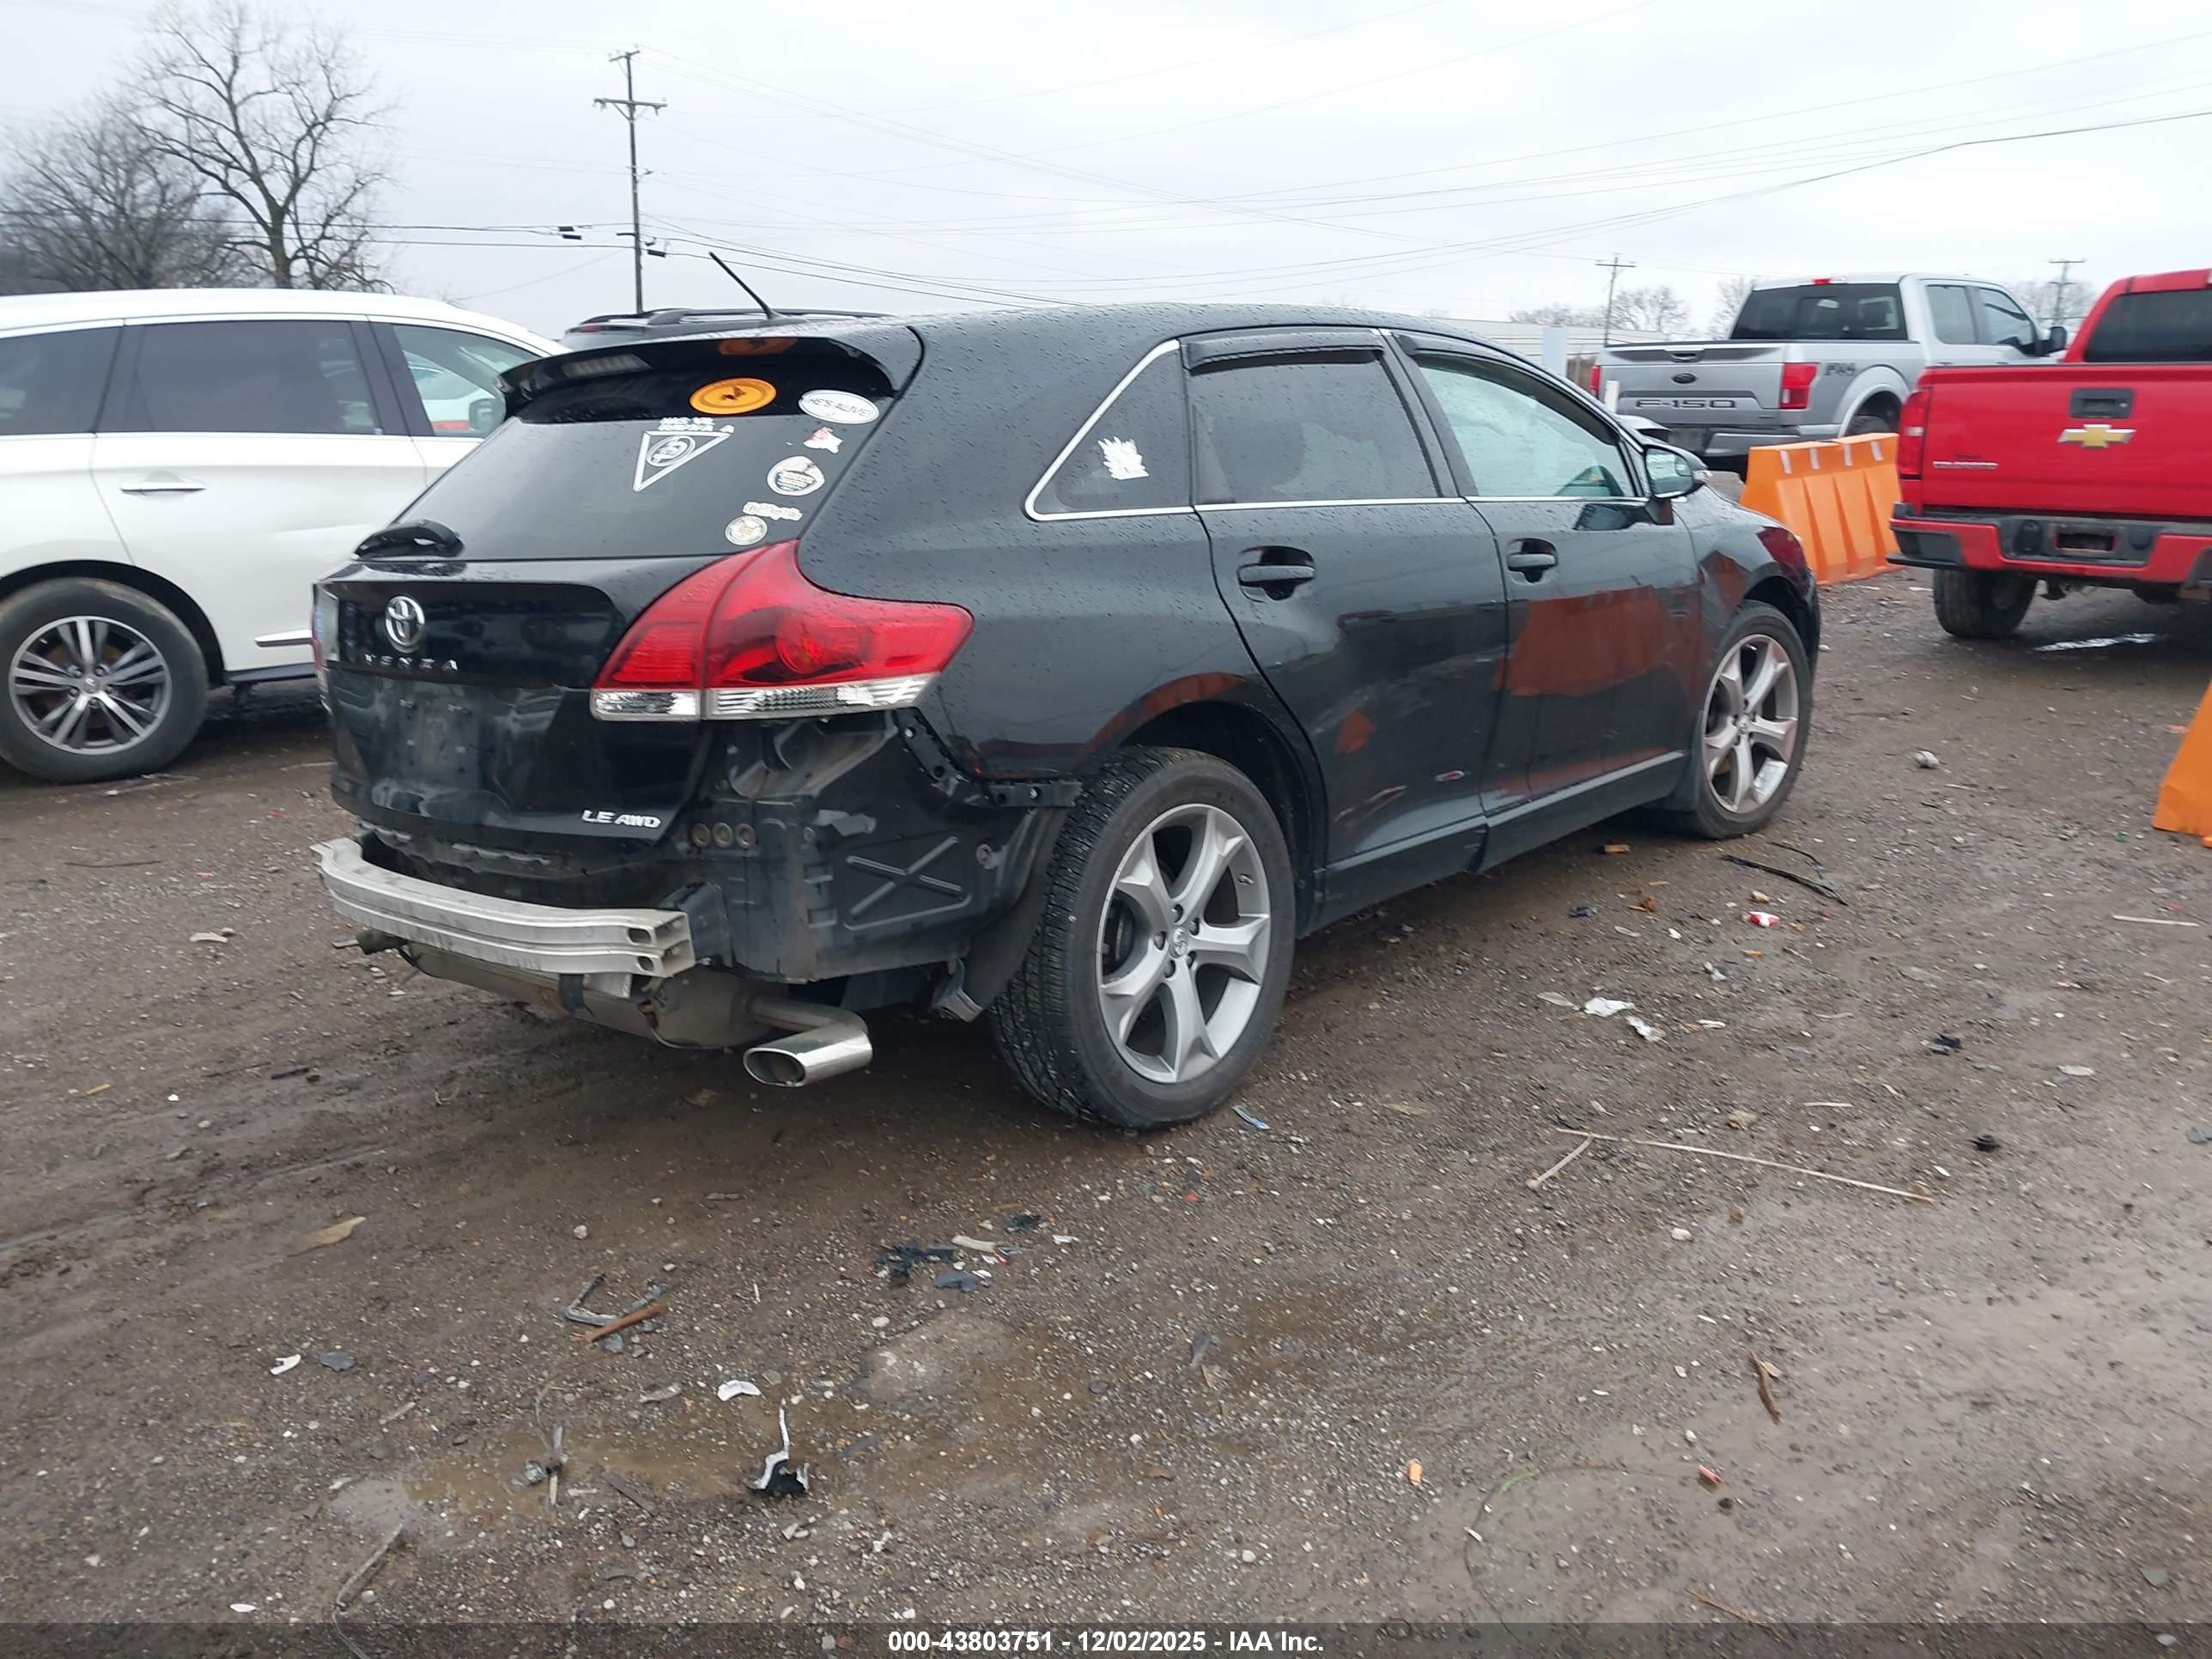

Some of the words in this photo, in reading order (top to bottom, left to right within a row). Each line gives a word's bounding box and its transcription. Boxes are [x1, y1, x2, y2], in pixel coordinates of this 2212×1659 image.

[1635, 398, 1737, 410] F-150
[363, 653, 459, 672] VENZA
[581, 809, 617, 824] LE
[613, 813, 661, 829] AWD
